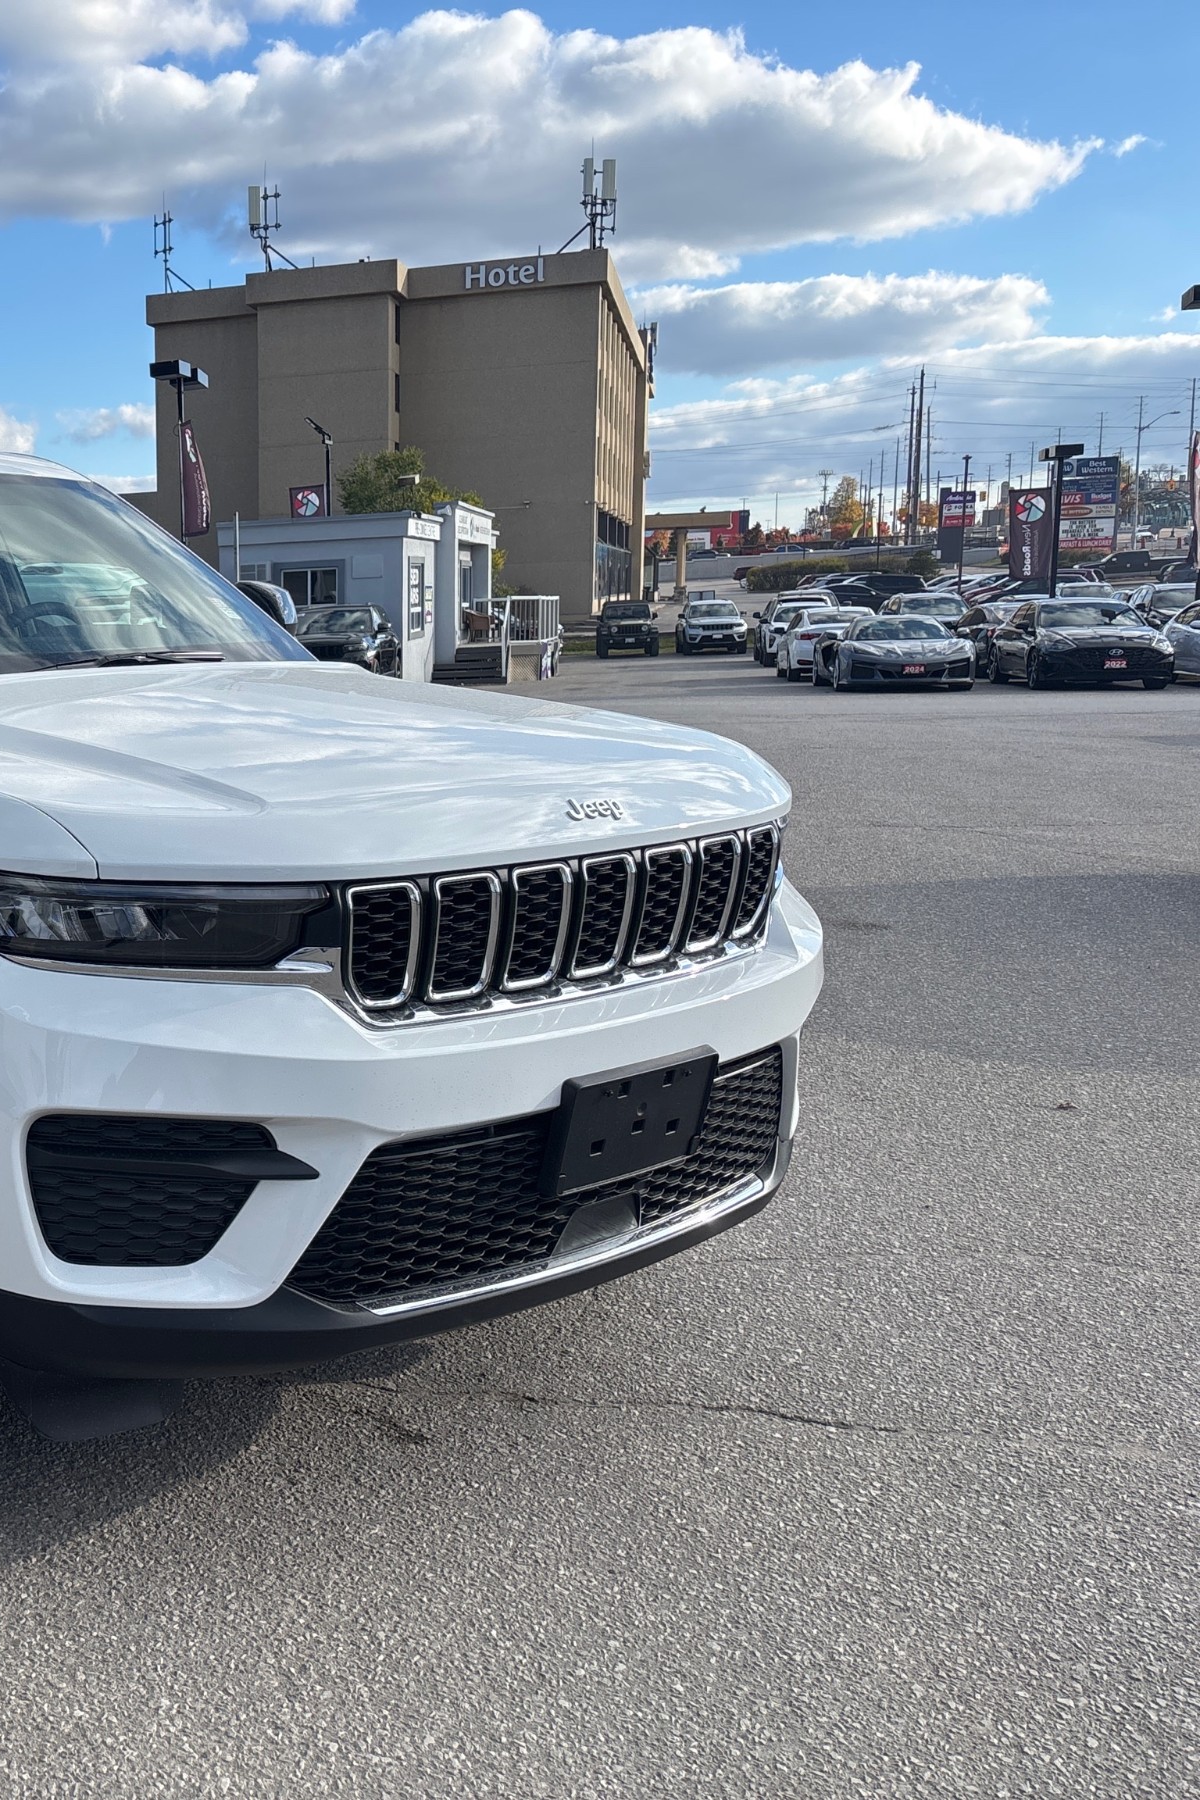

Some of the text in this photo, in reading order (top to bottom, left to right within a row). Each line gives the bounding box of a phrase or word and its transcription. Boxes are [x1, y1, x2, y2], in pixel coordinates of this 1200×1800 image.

[465, 257, 545, 289] Hotel
[1081, 466, 1113, 474] Western
[1103, 660, 1128, 670] 2022
[903, 666, 925, 675] 2024
[566, 798, 625, 821] Jeep
